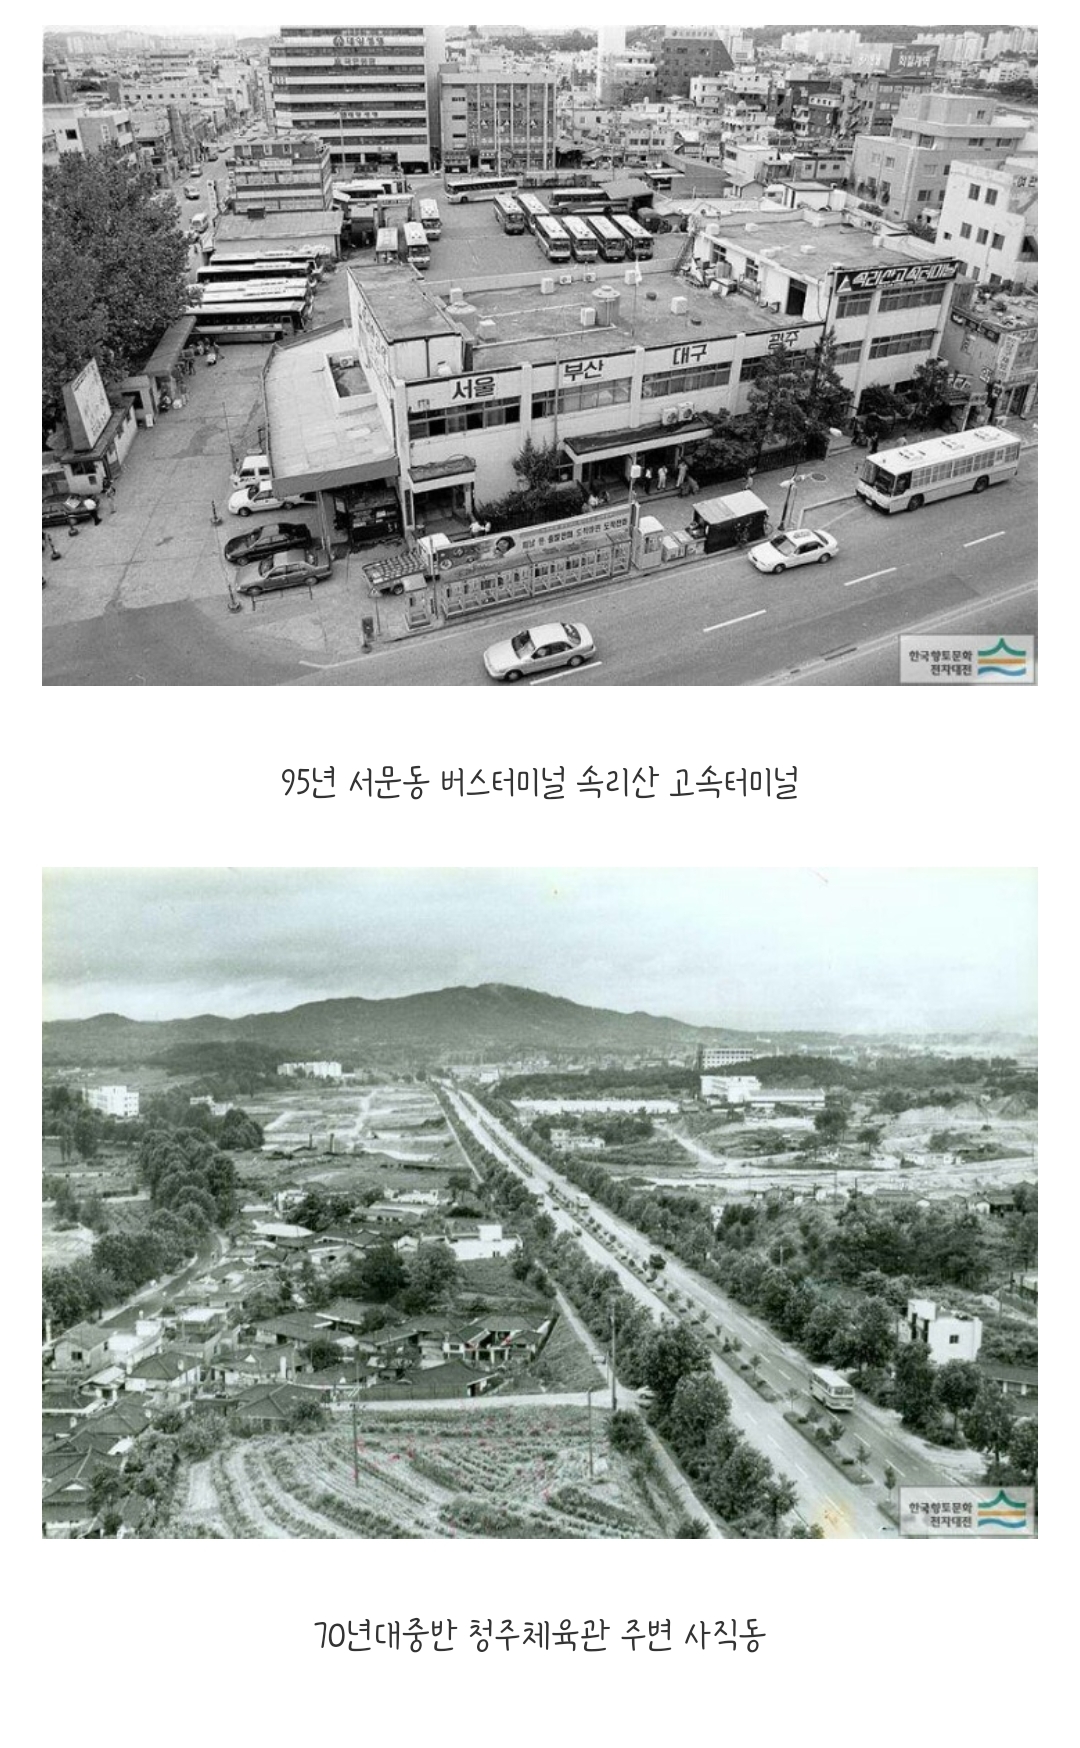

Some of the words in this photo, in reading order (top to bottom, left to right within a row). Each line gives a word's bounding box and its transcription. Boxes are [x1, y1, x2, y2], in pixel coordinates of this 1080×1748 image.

[767, 330, 800, 350] 광주
[672, 344, 708, 366] 대구
[563, 359, 604, 382] 부산
[452, 376, 496, 400] 서울
